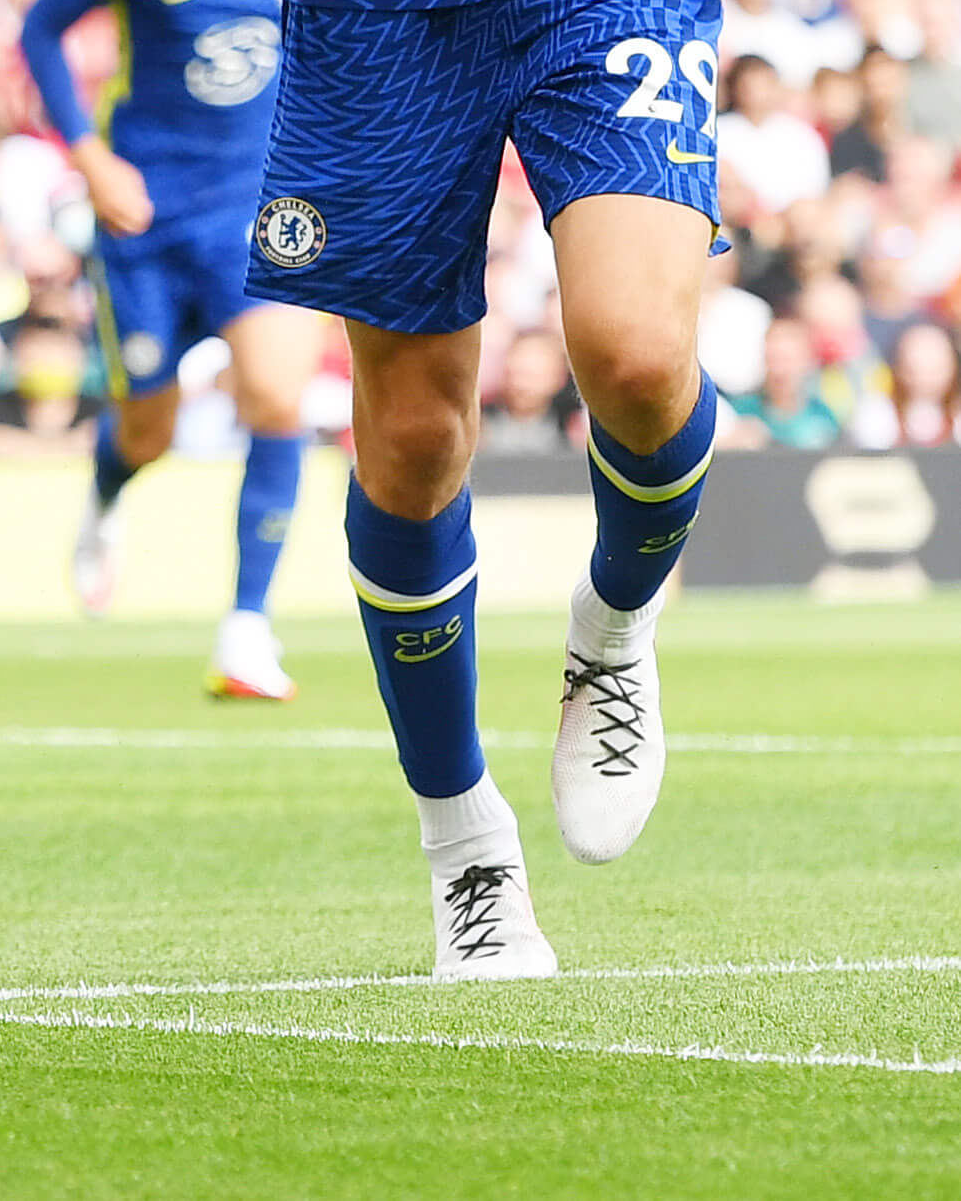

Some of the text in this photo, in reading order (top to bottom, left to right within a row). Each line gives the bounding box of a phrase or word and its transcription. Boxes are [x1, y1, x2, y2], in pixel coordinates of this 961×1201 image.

[605, 37, 718, 139] 29
[271, 201, 315, 219] CHELSEA
[395, 614, 462, 646] CFC
